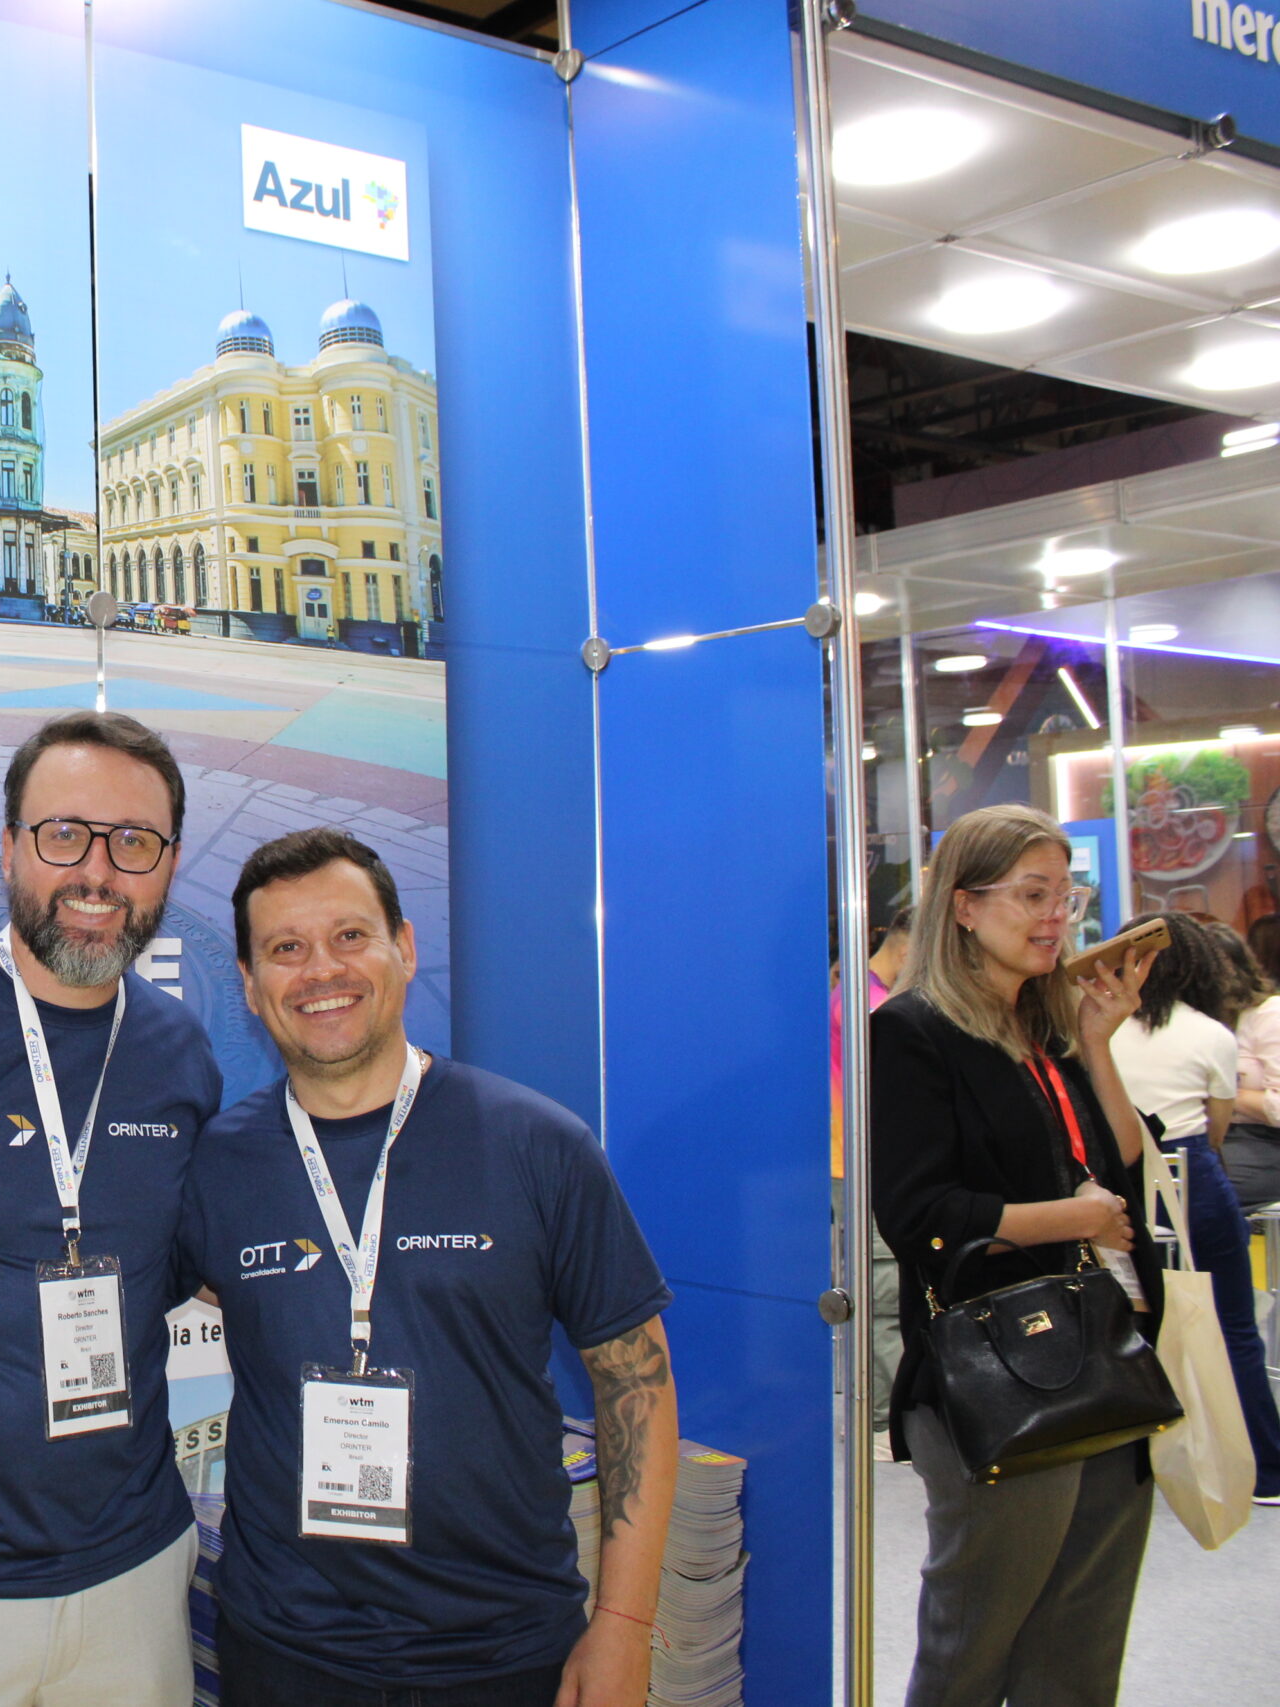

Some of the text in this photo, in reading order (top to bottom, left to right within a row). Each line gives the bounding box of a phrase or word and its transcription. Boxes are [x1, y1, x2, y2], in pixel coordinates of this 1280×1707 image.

[253, 160, 352, 222] Azul
[394, 1088, 415, 1128] ORINTER
[107, 1122, 169, 1138] ORINTER
[396, 1234, 477, 1251] ORINTER
[239, 1240, 287, 1268] OTT
[365, 1233, 378, 1278] ORINTER
[240, 1266, 286, 1280] Consolidadora
[77, 1288, 95, 1298] wtm
[58, 1308, 109, 1321] Roberto Sanches
[72, 1400, 107, 1412] EXHIBITOR
[349, 1397, 375, 1407] wtm
[323, 1416, 390, 1429] Emerson Camilo
[330, 1508, 377, 1520] EXHIBITOR
